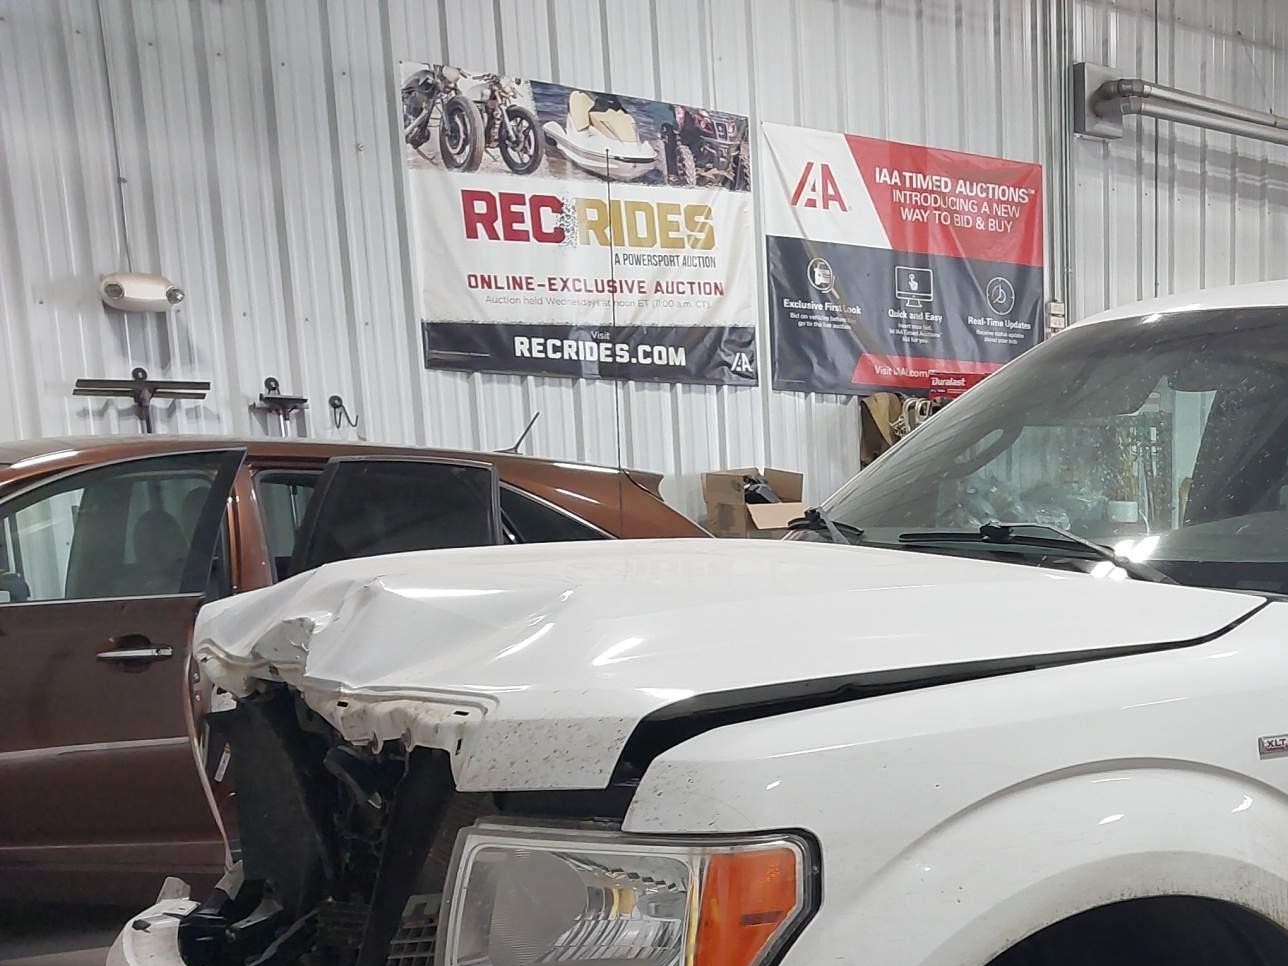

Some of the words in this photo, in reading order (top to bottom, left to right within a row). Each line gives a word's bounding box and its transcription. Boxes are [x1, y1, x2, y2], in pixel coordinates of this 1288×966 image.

[875, 167, 900, 186] IAA
[902, 171, 951, 193] TIMED
[892, 189, 978, 212] INTRODUCING
[980, 201, 990, 215] A
[993, 203, 1020, 218] NEW
[461, 189, 566, 244] REC
[576, 197, 716, 250] RIDES
[900, 206, 930, 223] WAY
[933, 210, 950, 225] TO
[953, 214, 973, 228] BID
[975, 216, 986, 231] &
[988, 218, 1013, 233] BUY
[614, 253, 621, 266] A
[623, 253, 681, 267] POWERSPORT
[682, 254, 717, 268] AUCTION
[467, 274, 647, 295] ONLINE-EXCLUSIVE
[654, 280, 725, 296] AUCTION
[485, 295, 520, 305] Auction
[523, 295, 544, 305] held
[783, 298, 823, 311] Exclusive
[824, 301, 842, 313] First
[888, 308, 907, 319] Quick
[909, 311, 923, 320] and
[925, 312, 943, 324] Easy
[967, 315, 1004, 327] Real-Time
[1004, 319, 1032, 330] Updates
[590, 330, 611, 340] Visit
[513, 336, 687, 367] RECRIDES.COM
[874, 364, 892, 376] Visit
[930, 377, 966, 388] Duralast
[1266, 738, 1287, 748] XLT
